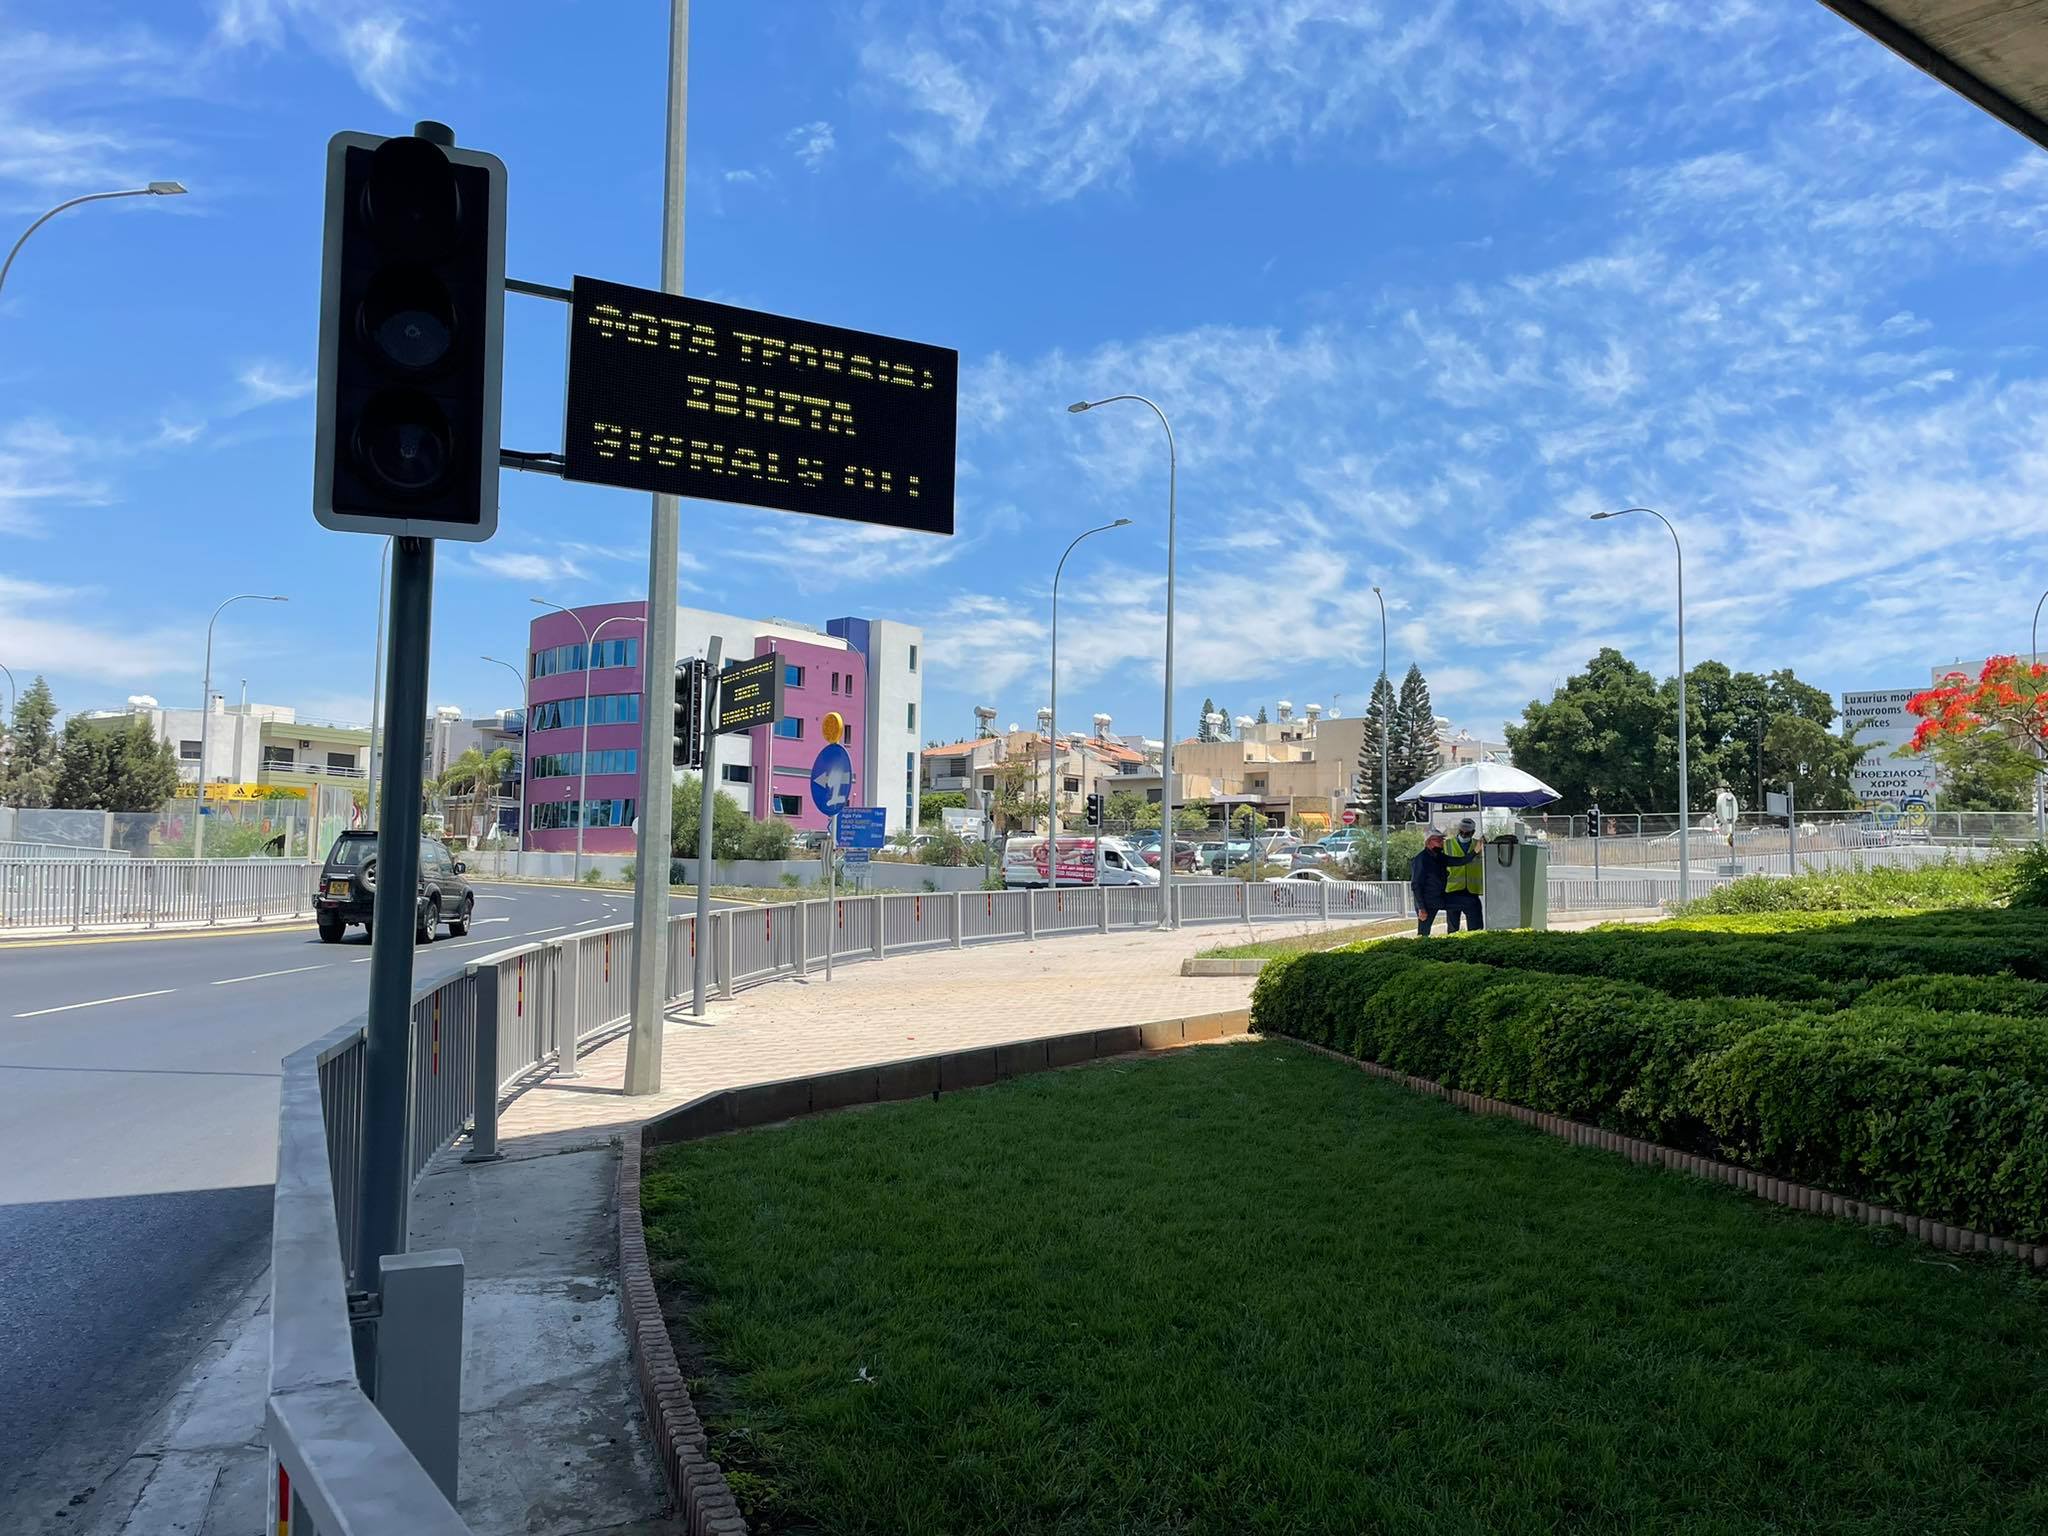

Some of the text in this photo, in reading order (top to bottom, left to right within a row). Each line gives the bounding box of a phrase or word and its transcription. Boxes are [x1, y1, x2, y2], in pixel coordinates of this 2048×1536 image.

[594, 422, 824, 487] SIGNALS
[1845, 694, 1888, 704] Luxurius
[1845, 706, 1902, 716] showrooms
[1845, 719, 1853, 728] &
[1855, 769, 1924, 779] ΕΚΘΕΣΙΑΚΟΣ
[1860, 789, 1907, 798] ΓΡΑΦΕΙΑ
